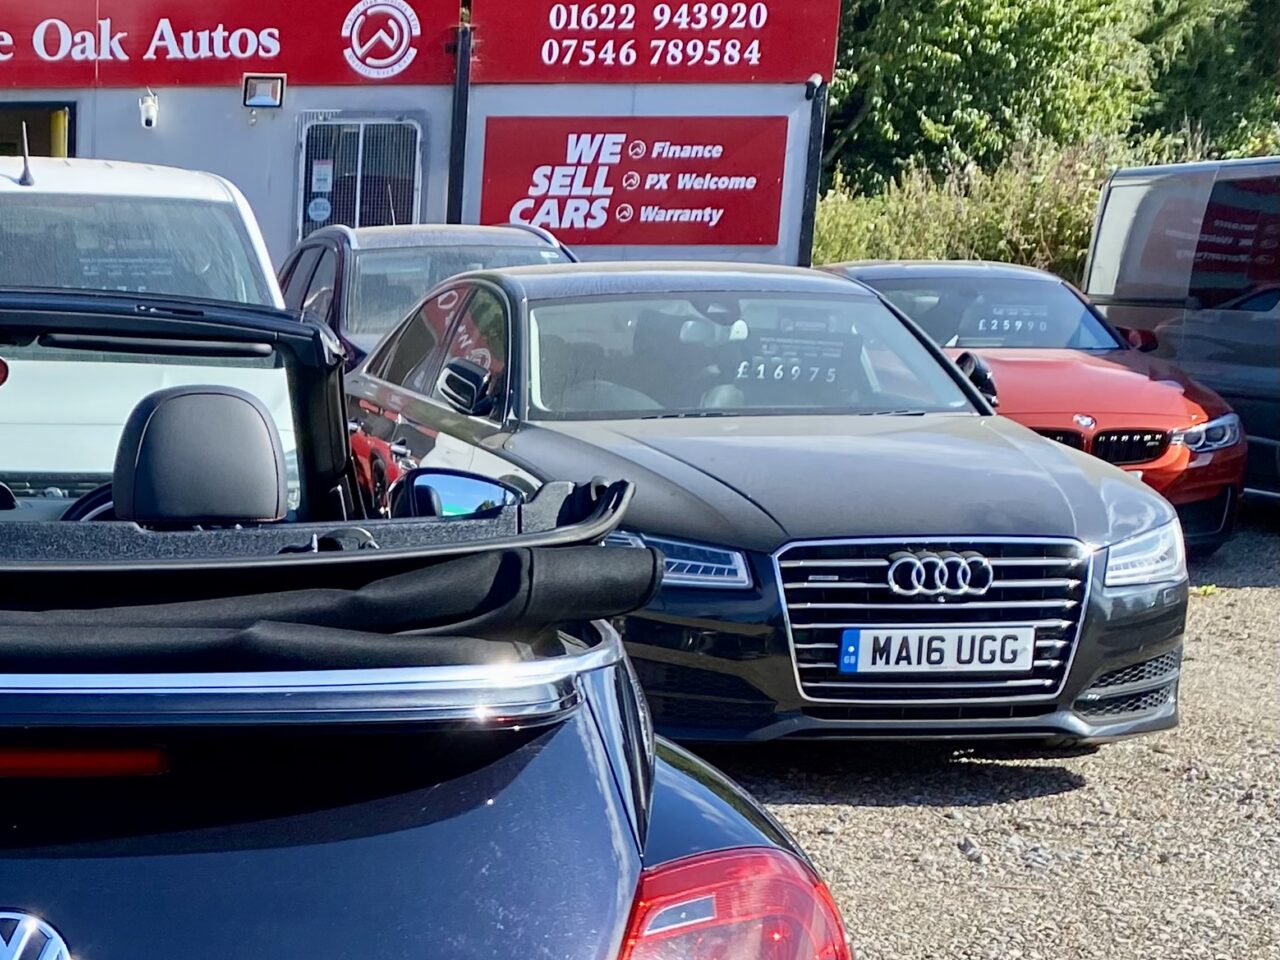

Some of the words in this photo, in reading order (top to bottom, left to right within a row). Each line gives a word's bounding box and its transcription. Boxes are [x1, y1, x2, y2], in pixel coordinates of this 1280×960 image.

[549, 3, 636, 30] 01622
[653, 2, 768, 30] 943920
[32, 18, 130, 62] Oak
[142, 18, 281, 61] Autos
[541, 39, 638, 66] 07546
[649, 39, 762, 66] 789584
[566, 133, 626, 164] WE
[651, 142, 723, 158] Finance
[528, 165, 613, 197] SELL
[644, 173, 672, 190] PX
[677, 173, 757, 190] Welcome
[509, 198, 610, 229] CARS
[639, 206, 724, 226] Warranty
[978, 319, 1047, 331] £25990
[736, 360, 837, 383] £16975
[871, 635, 946, 665] MA16
[956, 635, 1019, 665] UGG
